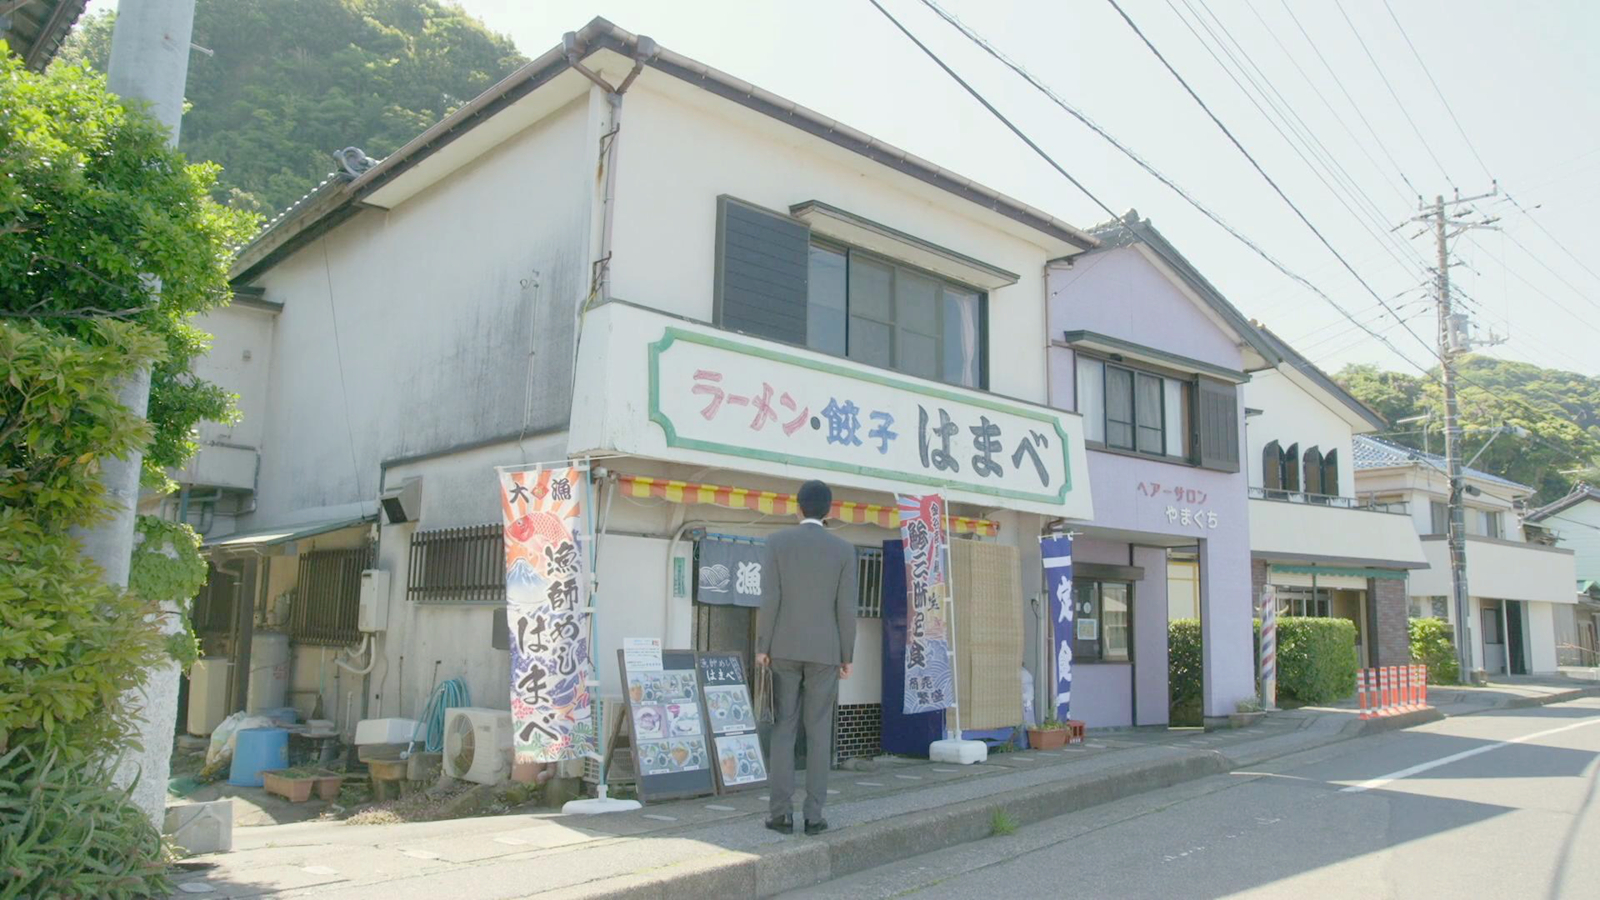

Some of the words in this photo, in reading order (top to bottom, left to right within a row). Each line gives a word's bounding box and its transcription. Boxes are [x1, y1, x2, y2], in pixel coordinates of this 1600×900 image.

[691, 369, 899, 455] ラーメン・餃子
[917, 404, 1049, 488] はまべ
[509, 477, 572, 504] 大漁
[1137, 481, 1207, 505] ヘアーサロン
[1165, 505, 1218, 529] やまぐち
[736, 560, 763, 596] 漁
[544, 541, 580, 676] 漁師めし
[1056, 575, 1074, 684] 定食
[517, 613, 560, 742] はまべ
[706, 668, 736, 682] はまべ
